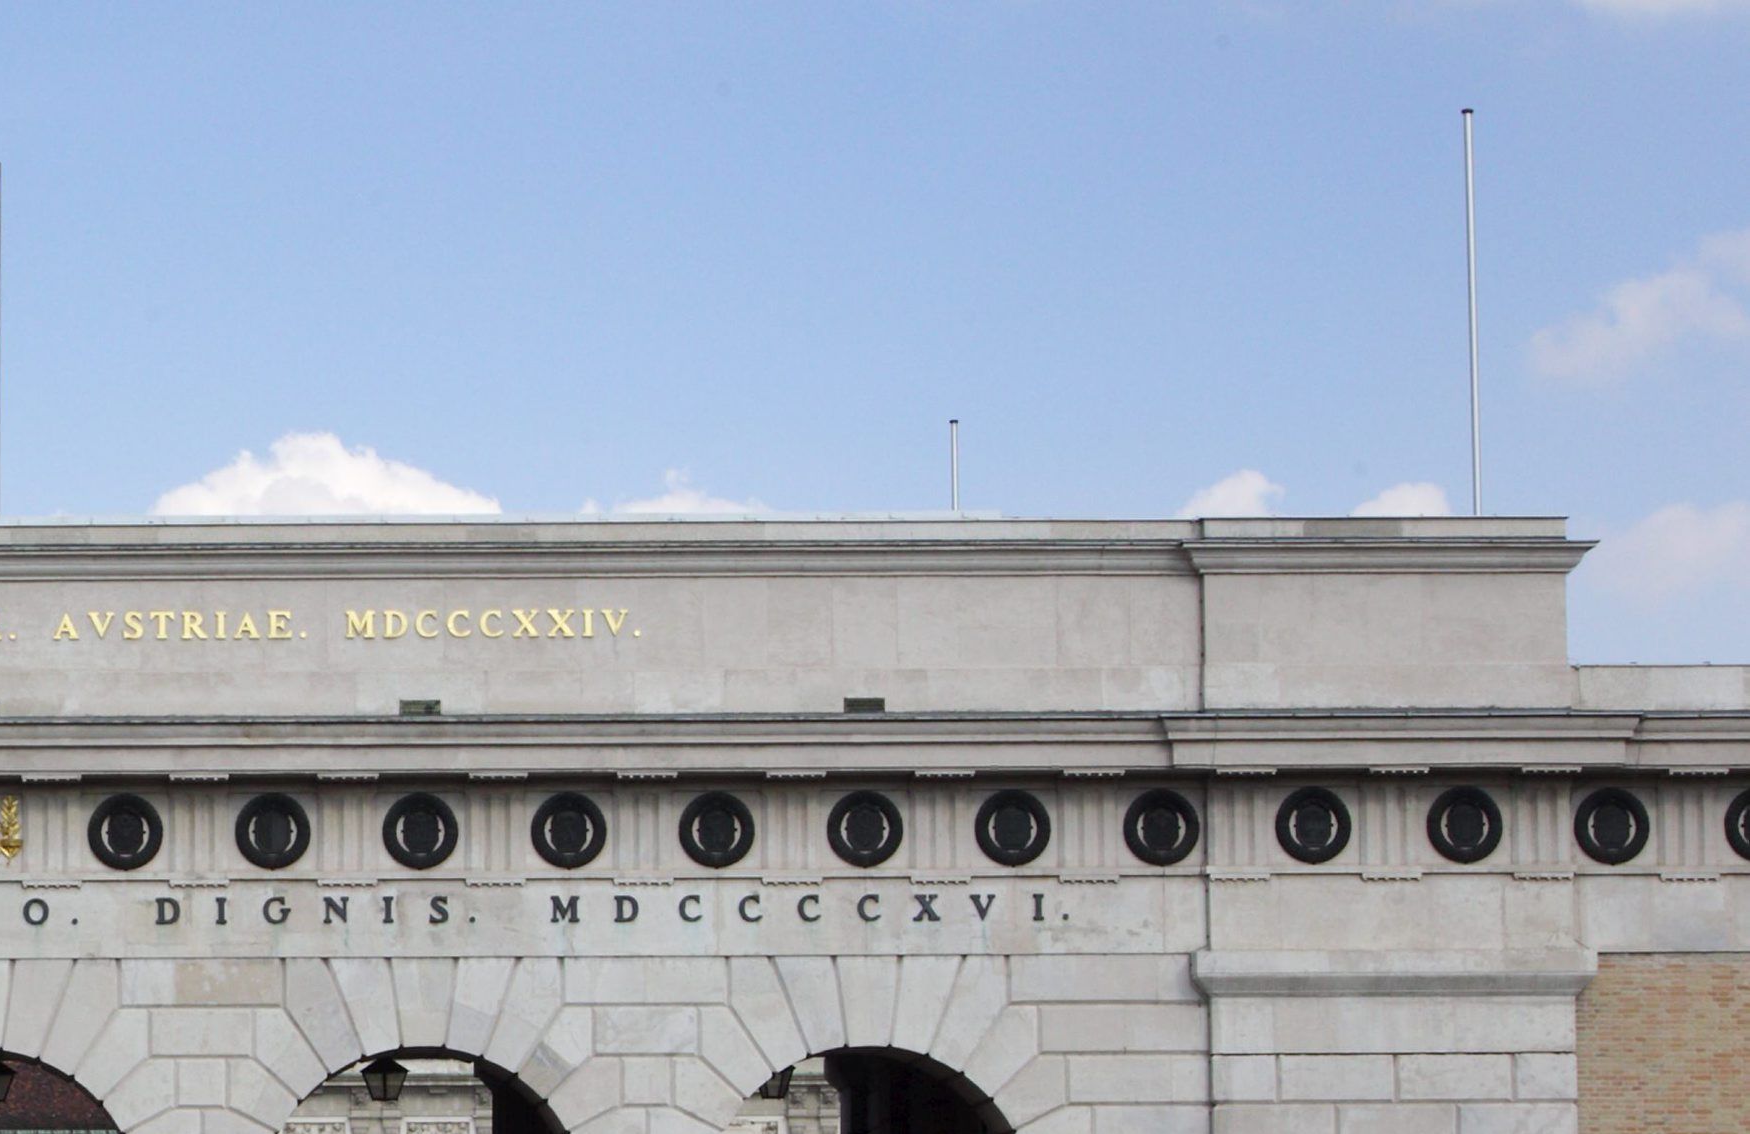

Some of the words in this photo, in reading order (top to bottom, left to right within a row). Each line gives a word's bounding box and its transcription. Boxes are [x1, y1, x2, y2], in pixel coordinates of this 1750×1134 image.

[53, 609, 307, 641] AVSTRIAE.
[346, 607, 641, 639] MDCCCXXIV.
[155, 895, 476, 926] DIGNIS.
[550, 894, 1069, 924] MDCCCCXVI.
